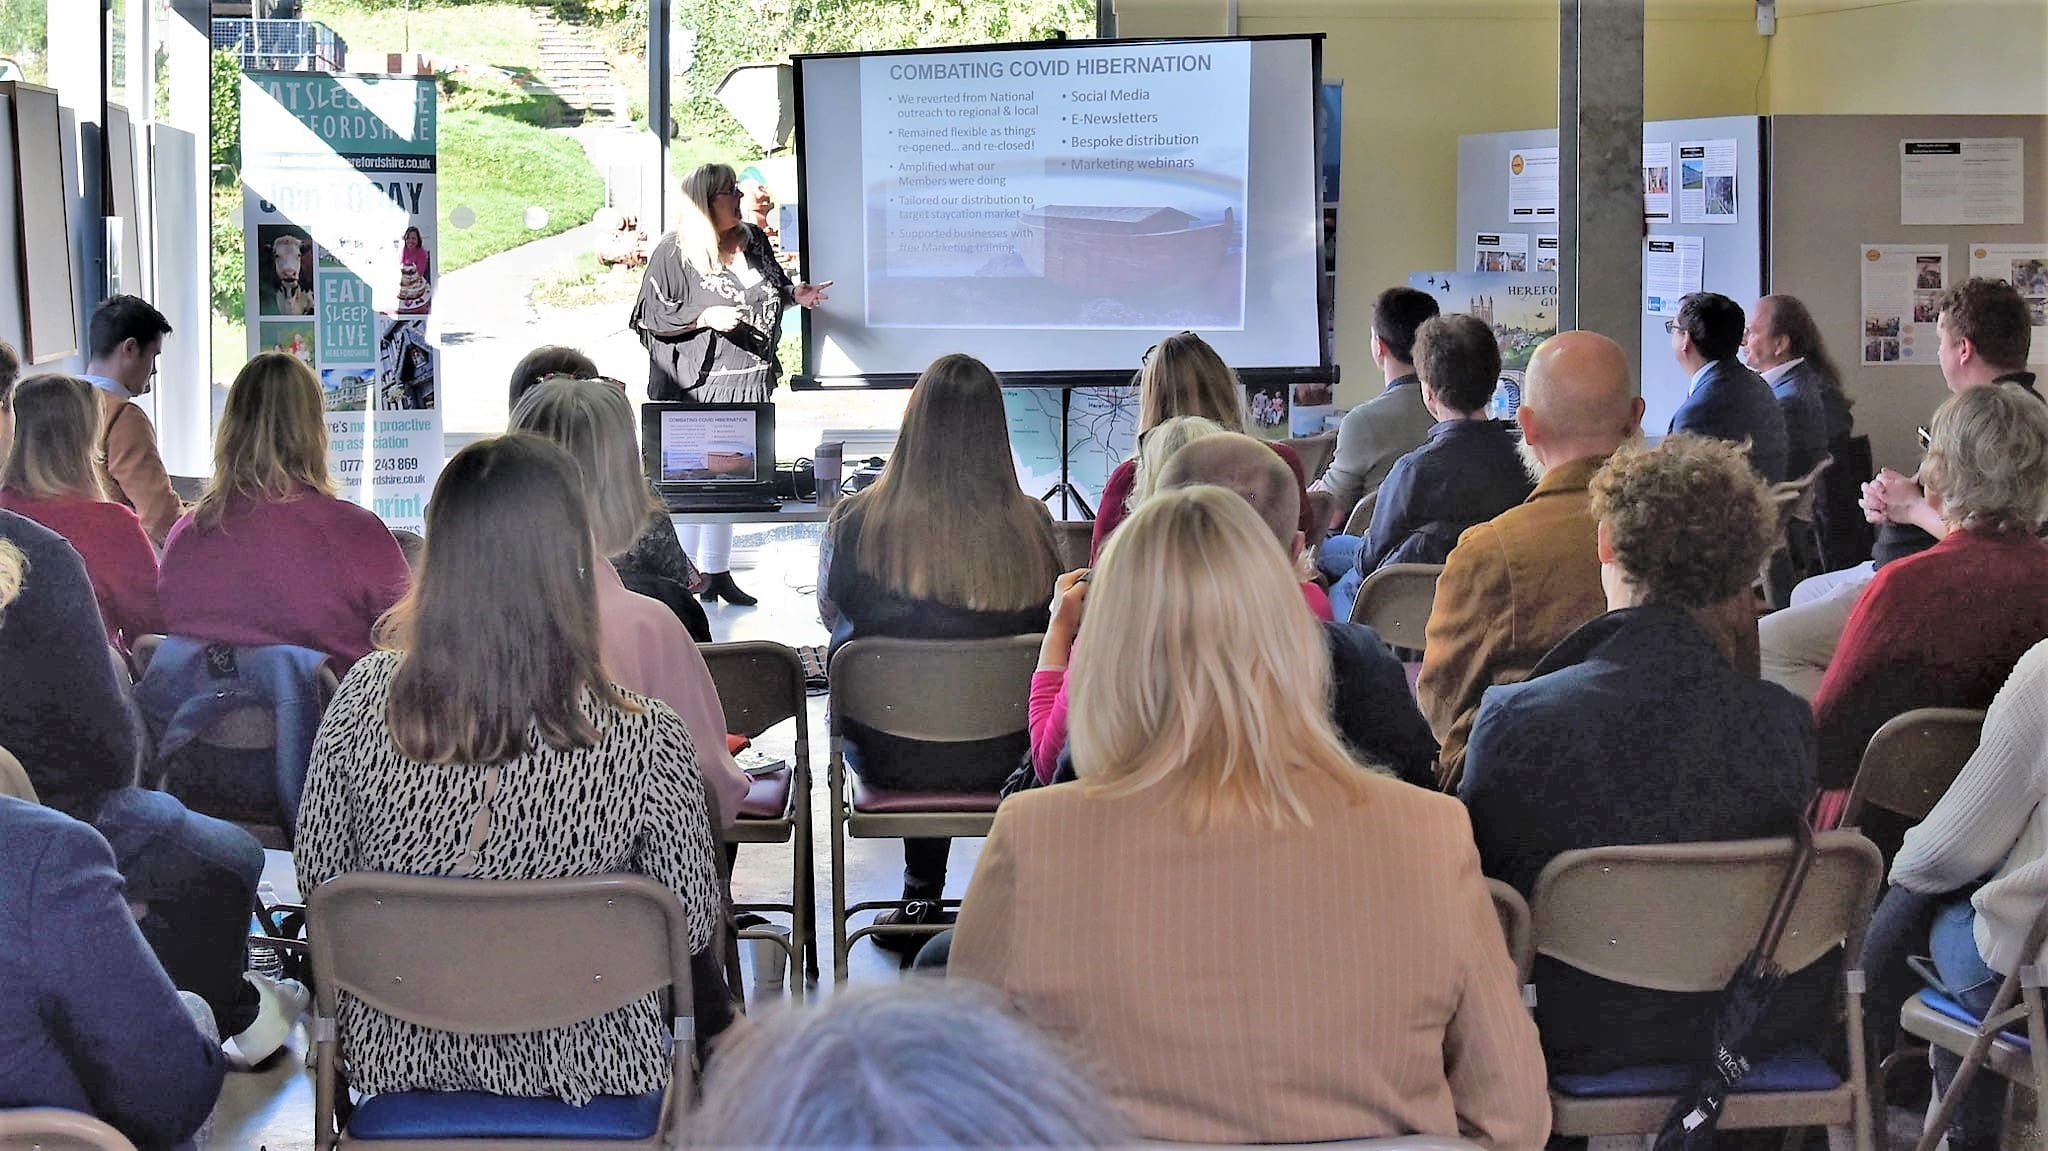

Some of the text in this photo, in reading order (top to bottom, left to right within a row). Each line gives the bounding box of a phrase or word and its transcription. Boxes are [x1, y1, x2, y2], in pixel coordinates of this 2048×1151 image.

[890, 54, 1212, 80] COMBATING COVID HIBERNATION
[246, 82, 300, 110] AT
[897, 90, 1034, 104] We reverted from National
[1071, 88, 1150, 102] Social Media
[897, 105, 1039, 119] outreach to regional & local
[1071, 112, 1159, 125] E-Newsletters
[898, 125, 1036, 138] Remained flexible as things
[962, 140, 981, 151] and
[983, 140, 1035, 151] re-closed!
[1071, 133, 1199, 149] Bespoke distribution
[898, 161, 996, 174] Amplified what our
[1071, 156, 1195, 172] Marketing webinars
[898, 174, 1006, 187] Members were doing
[899, 194, 1034, 206] Tailored our distribution to
[899, 208, 1021, 221] target staycation market
[899, 228, 1034, 241] Supported businesses with
[899, 242, 1015, 255] free Marketing training
[325, 279, 366, 303] EAT
[325, 304, 368, 323] SLEEP
[327, 324, 368, 347] LIVE
[380, 419, 432, 434] proactive
[374, 458, 395, 471] 243
[397, 457, 418, 471] 869
